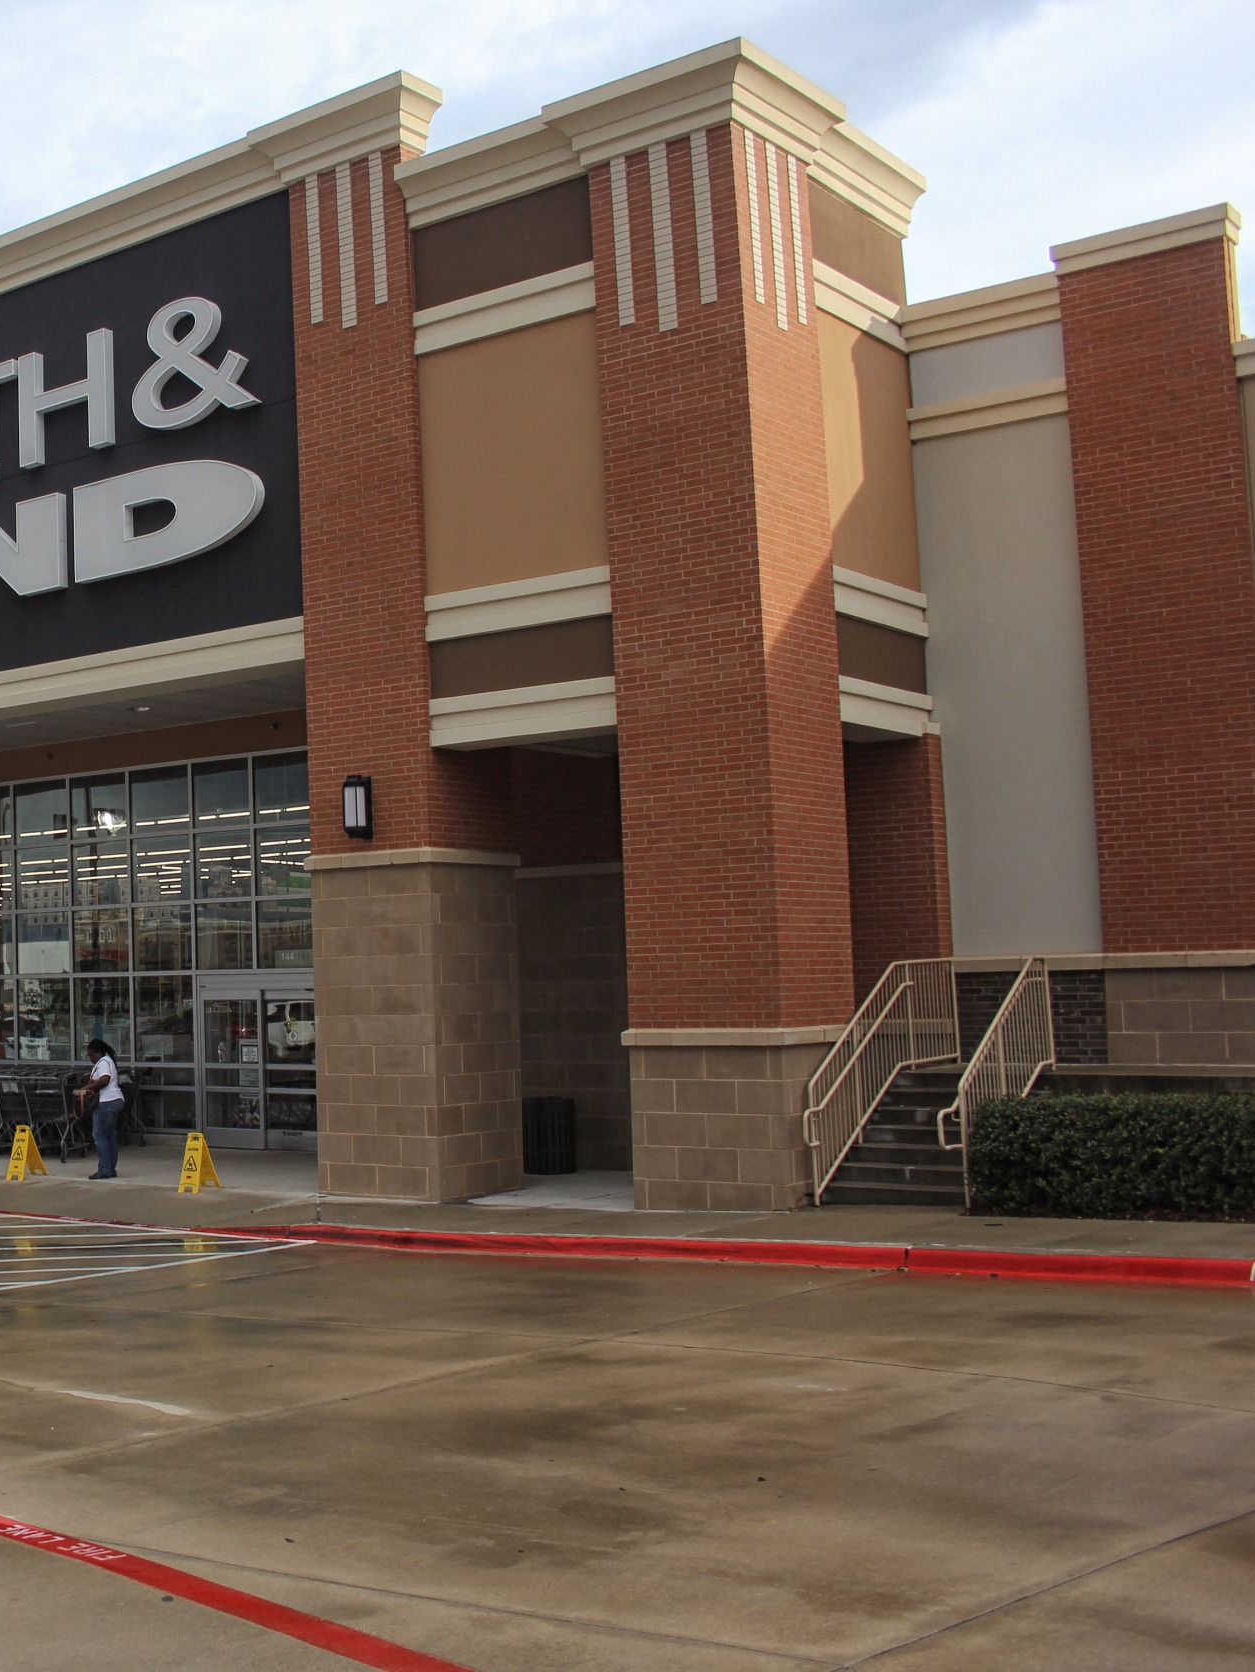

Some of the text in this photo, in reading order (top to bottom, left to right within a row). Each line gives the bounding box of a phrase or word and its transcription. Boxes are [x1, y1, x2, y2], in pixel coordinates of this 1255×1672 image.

[131, 296, 263, 430] &
[281, 952, 295, 961] 144
[56, 1542, 127, 1561] FIRE
